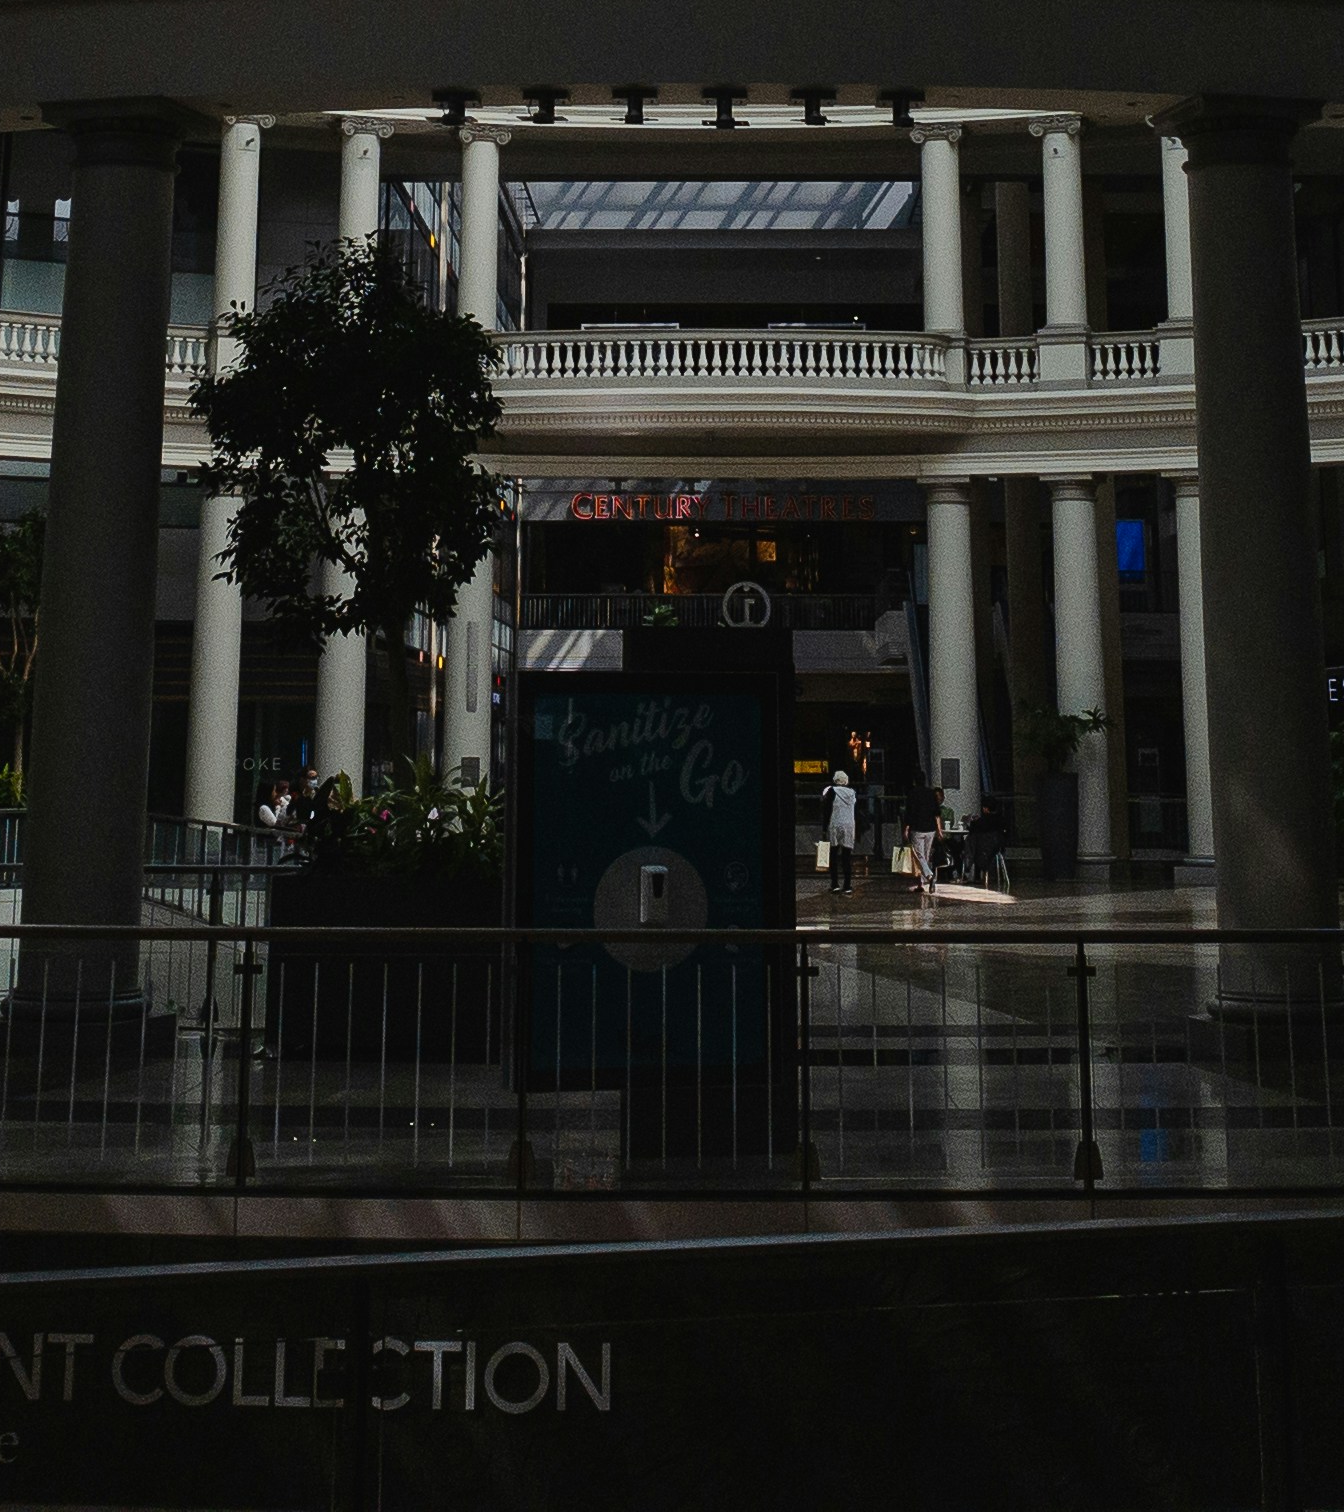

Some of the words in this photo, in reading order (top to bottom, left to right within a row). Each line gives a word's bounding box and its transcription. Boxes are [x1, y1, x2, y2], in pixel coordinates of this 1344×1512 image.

[570, 491, 710, 520] CENTURY
[721, 493, 875, 520] THEATRES
[557, 696, 715, 768] Sanitize
[609, 763, 634, 783] on
[640, 750, 672, 776] the
[680, 739, 750, 809] Go
[111, 1333, 612, 1414] COLLECTION
